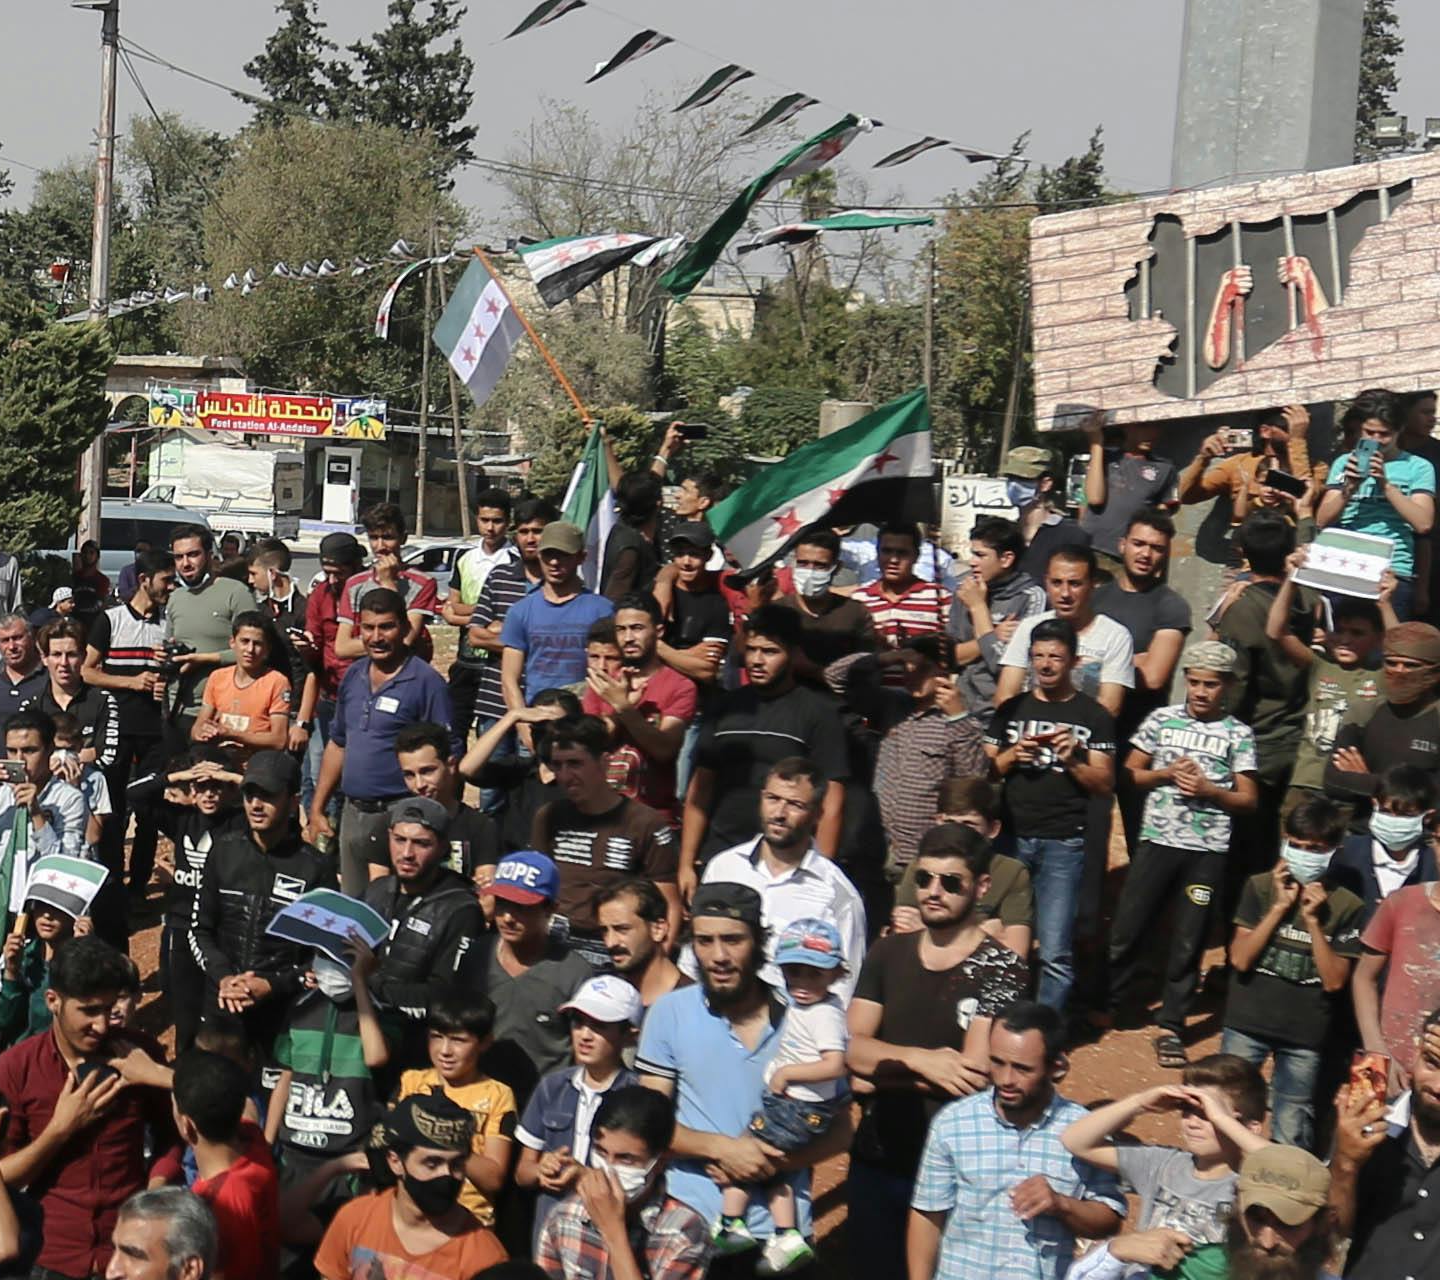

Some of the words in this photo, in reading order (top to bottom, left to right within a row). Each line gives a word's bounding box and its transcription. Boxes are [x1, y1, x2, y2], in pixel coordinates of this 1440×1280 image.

[196, 394, 267, 418] الأندلس
[269, 400, 333, 421] محطة
[211, 418, 231, 428] Fuel
[232, 420, 266, 431] station
[285, 1081, 355, 1120] FILA
